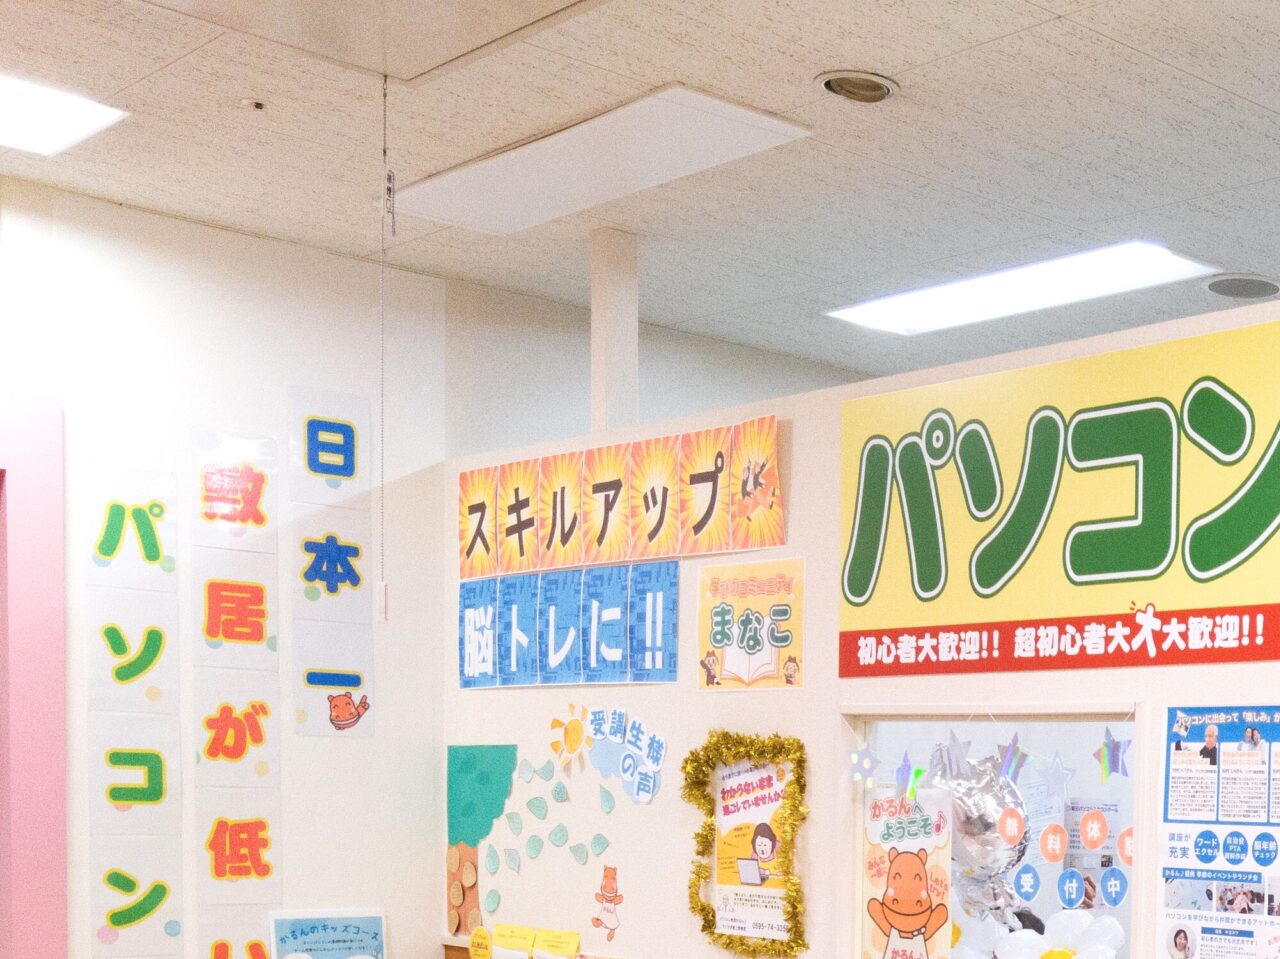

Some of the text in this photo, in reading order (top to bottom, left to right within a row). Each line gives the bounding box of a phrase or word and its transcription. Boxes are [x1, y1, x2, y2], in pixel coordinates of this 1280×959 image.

[465, 450, 725, 560] スキルアップ
[302, 416, 364, 690] 日本一
[710, 602, 792, 655] まなこ
[590, 709, 664, 767] 受講生様
[621, 753, 653, 797] の声
[1168, 846, 1190, 859] 充実
[1196, 837, 1218, 846] ワード
[1253, 850, 1276, 860] チェック
[1020, 872, 1120, 898] 受付中
